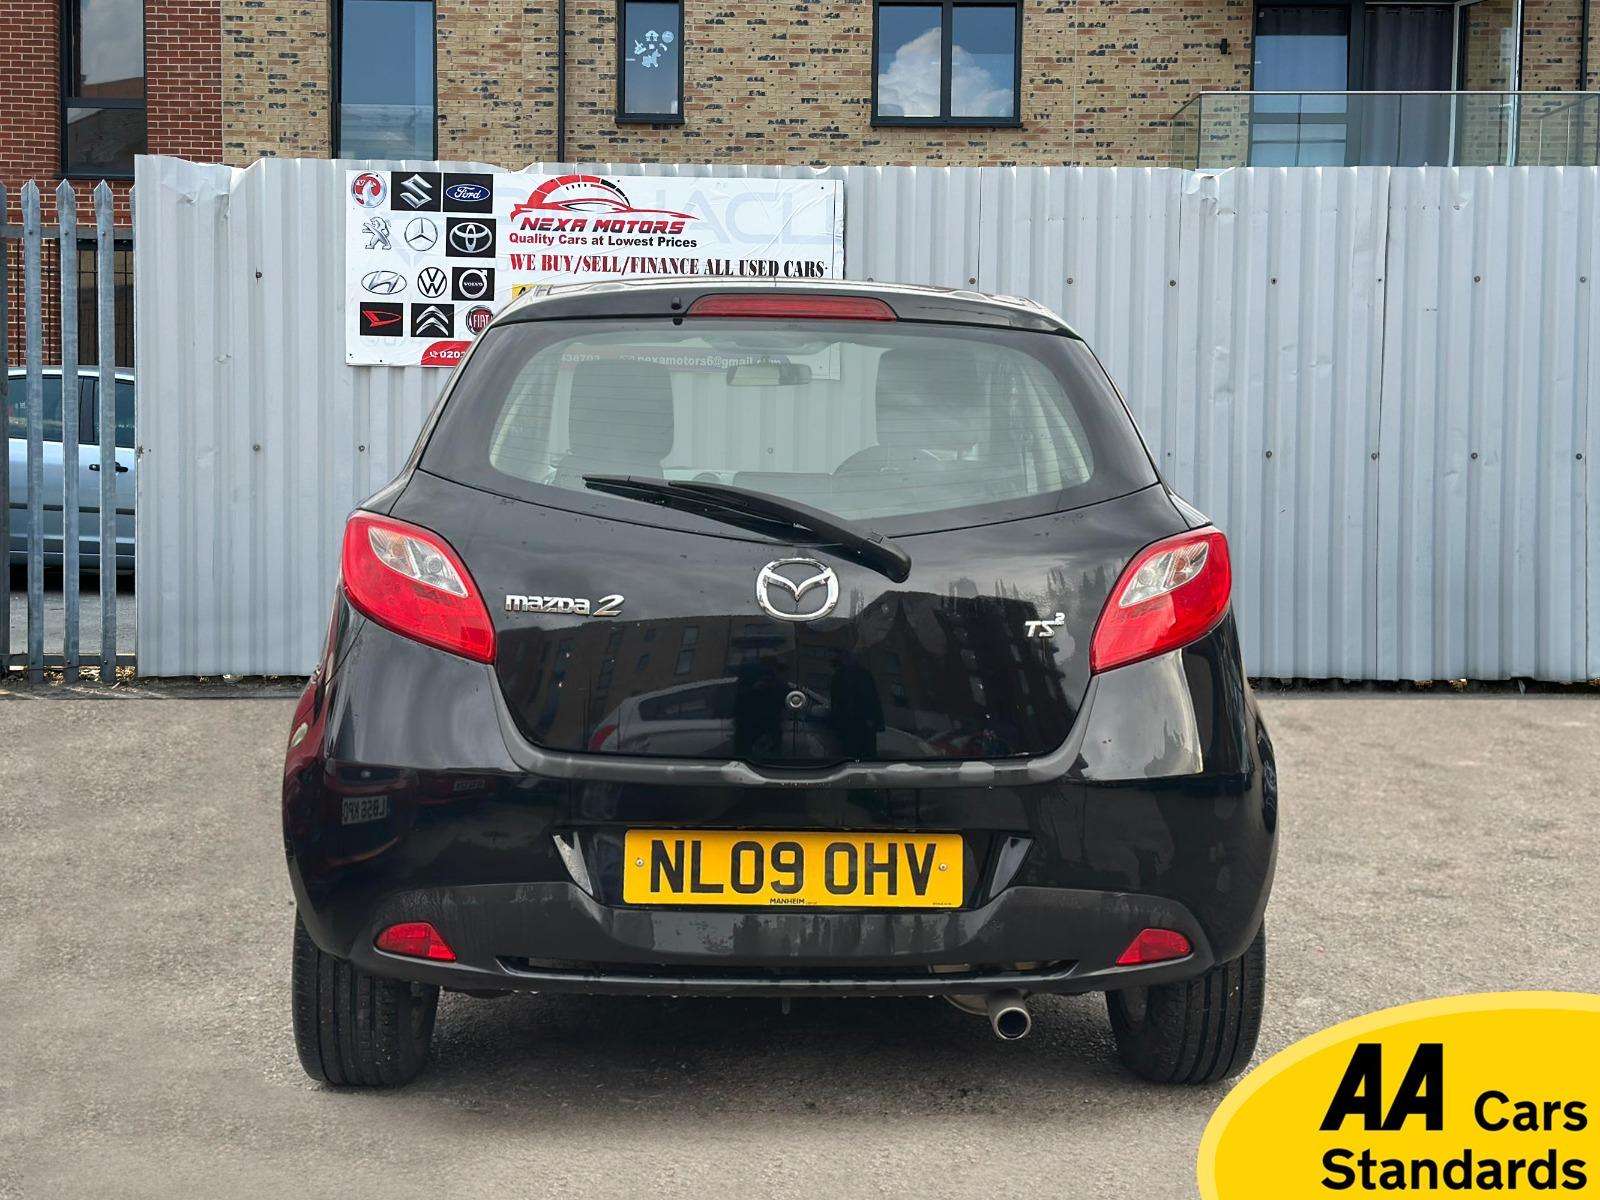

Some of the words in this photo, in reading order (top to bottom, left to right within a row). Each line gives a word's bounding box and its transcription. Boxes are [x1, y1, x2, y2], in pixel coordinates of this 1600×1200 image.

[454, 186, 482, 199] Ford
[519, 217, 588, 233] NEXA
[592, 219, 686, 235] MOTORS
[509, 232, 555, 246] Quality
[558, 234, 588, 246] Cars
[591, 235, 604, 246] at
[608, 235, 654, 247] Lowest
[657, 237, 698, 248] Prices
[510, 253, 536, 271] WE
[541, 254, 699, 276] BUY/SELL/FINANCE
[704, 258, 734, 276] ALL
[739, 259, 780, 277] USED
[783, 260, 825, 278] CARS
[473, 314, 490, 328] FIAT
[593, 594, 625, 617] 2
[649, 839, 805, 895] NL09
[824, 841, 937, 897] OHV
[769, 897, 805, 905] MANHEIM
